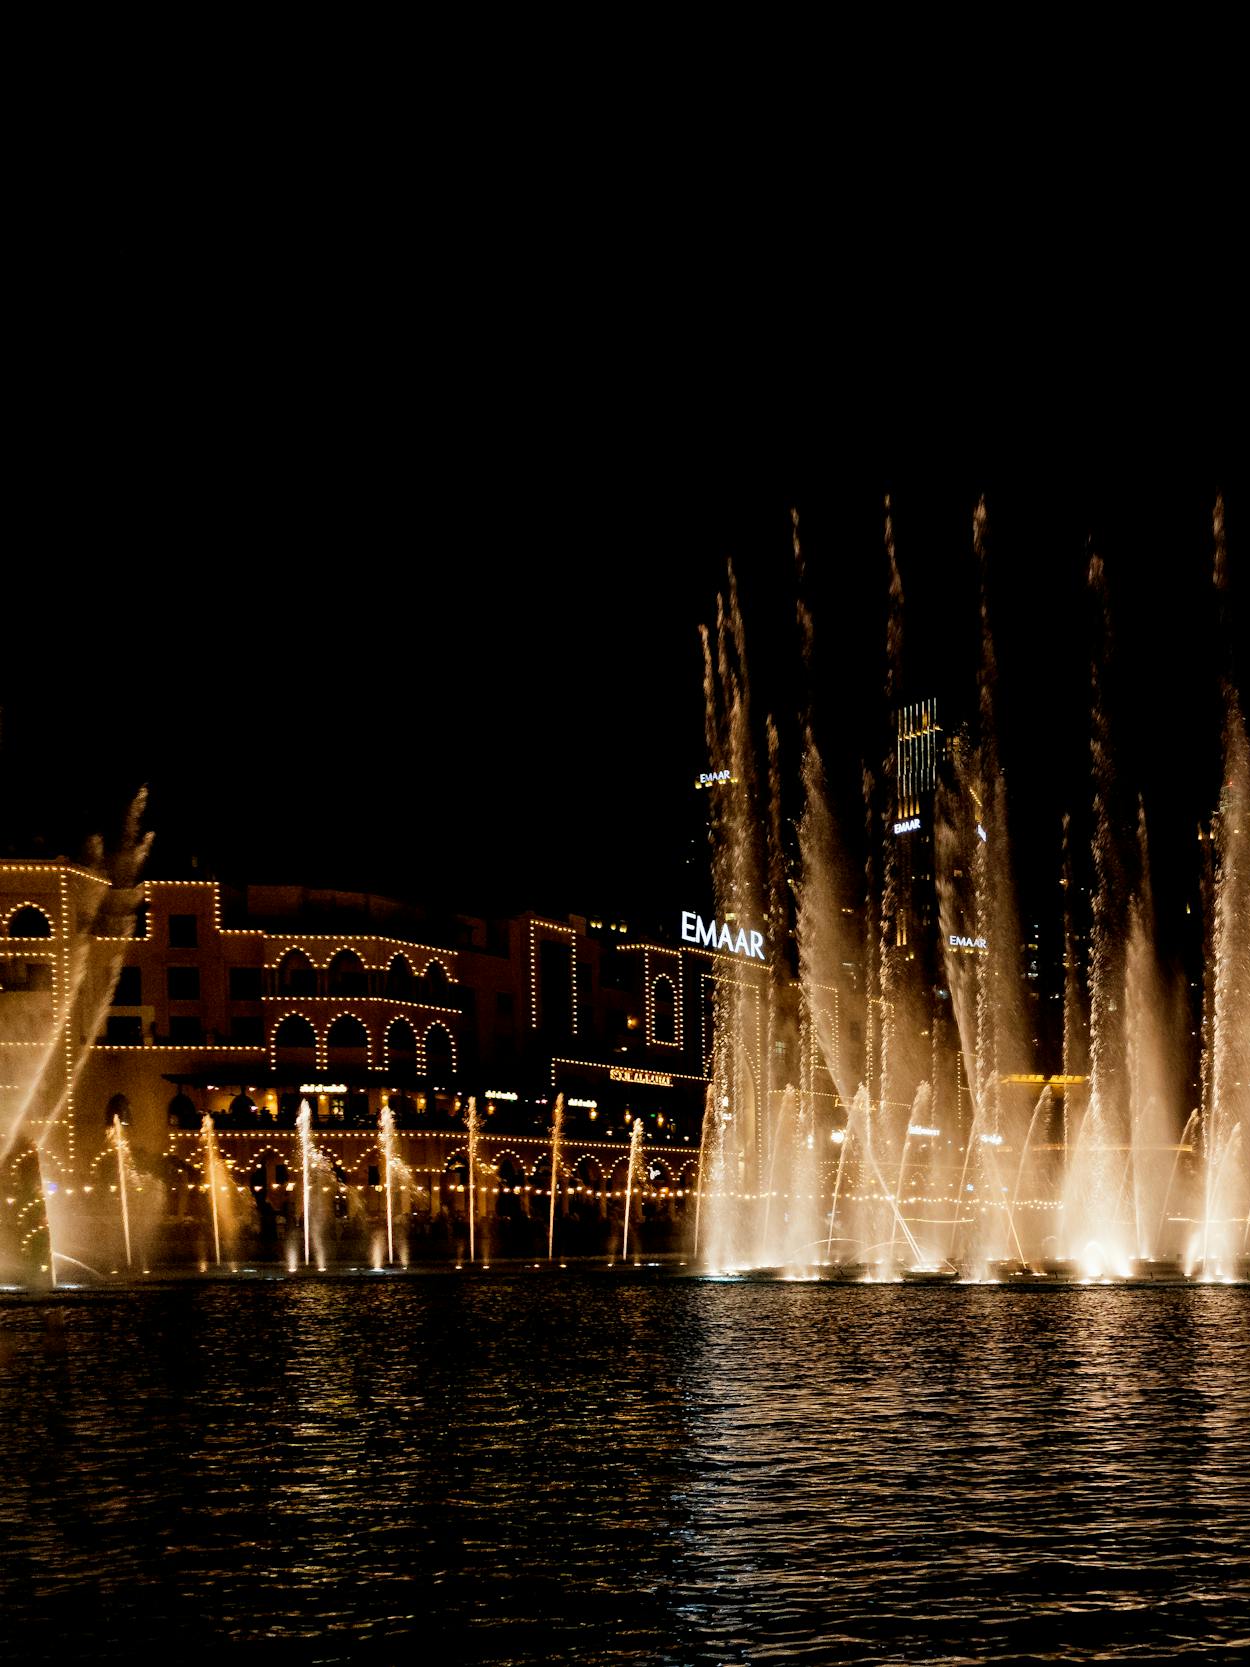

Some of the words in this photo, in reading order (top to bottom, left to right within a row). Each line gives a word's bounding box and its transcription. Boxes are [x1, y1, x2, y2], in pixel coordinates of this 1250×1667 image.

[700, 769, 731, 784] EMAAR
[681, 910, 766, 960] EMAAR
[949, 935, 988, 949] EMAAR
